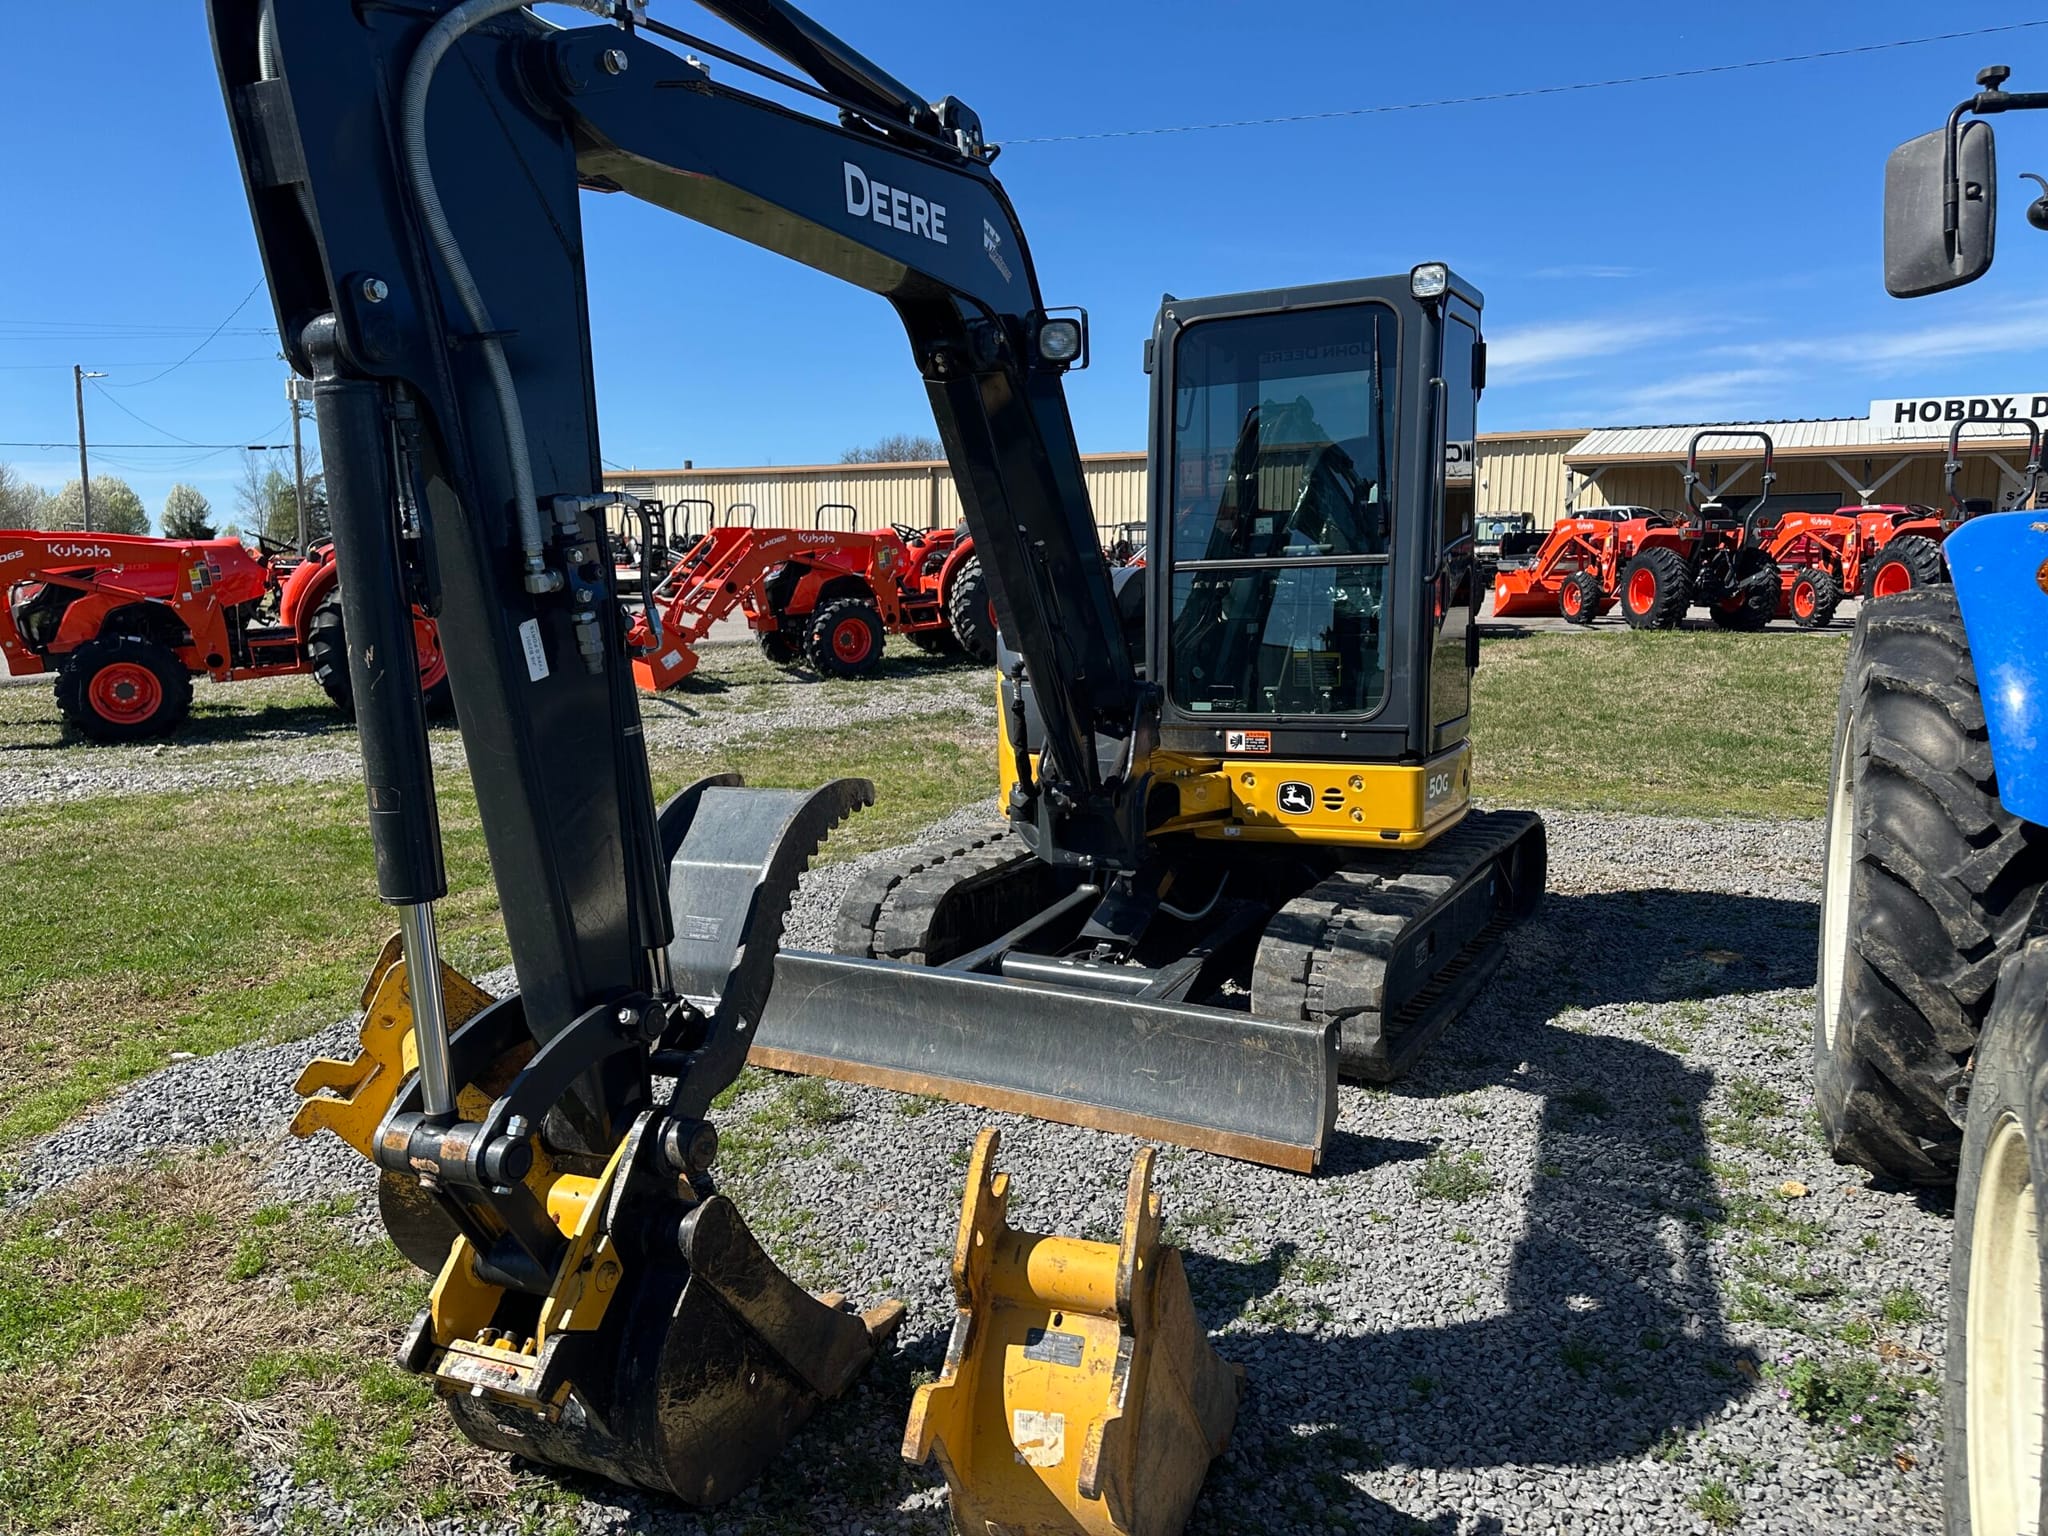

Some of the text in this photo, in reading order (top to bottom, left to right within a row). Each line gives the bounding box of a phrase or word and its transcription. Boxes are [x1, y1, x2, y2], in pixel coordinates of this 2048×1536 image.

[843, 161, 948, 245] DEERE
[1894, 397, 2017, 423] HOBDY,
[47, 543, 112, 558] Kubota
[798, 533, 835, 544] Kubota
[1428, 773, 1449, 798] 50G
